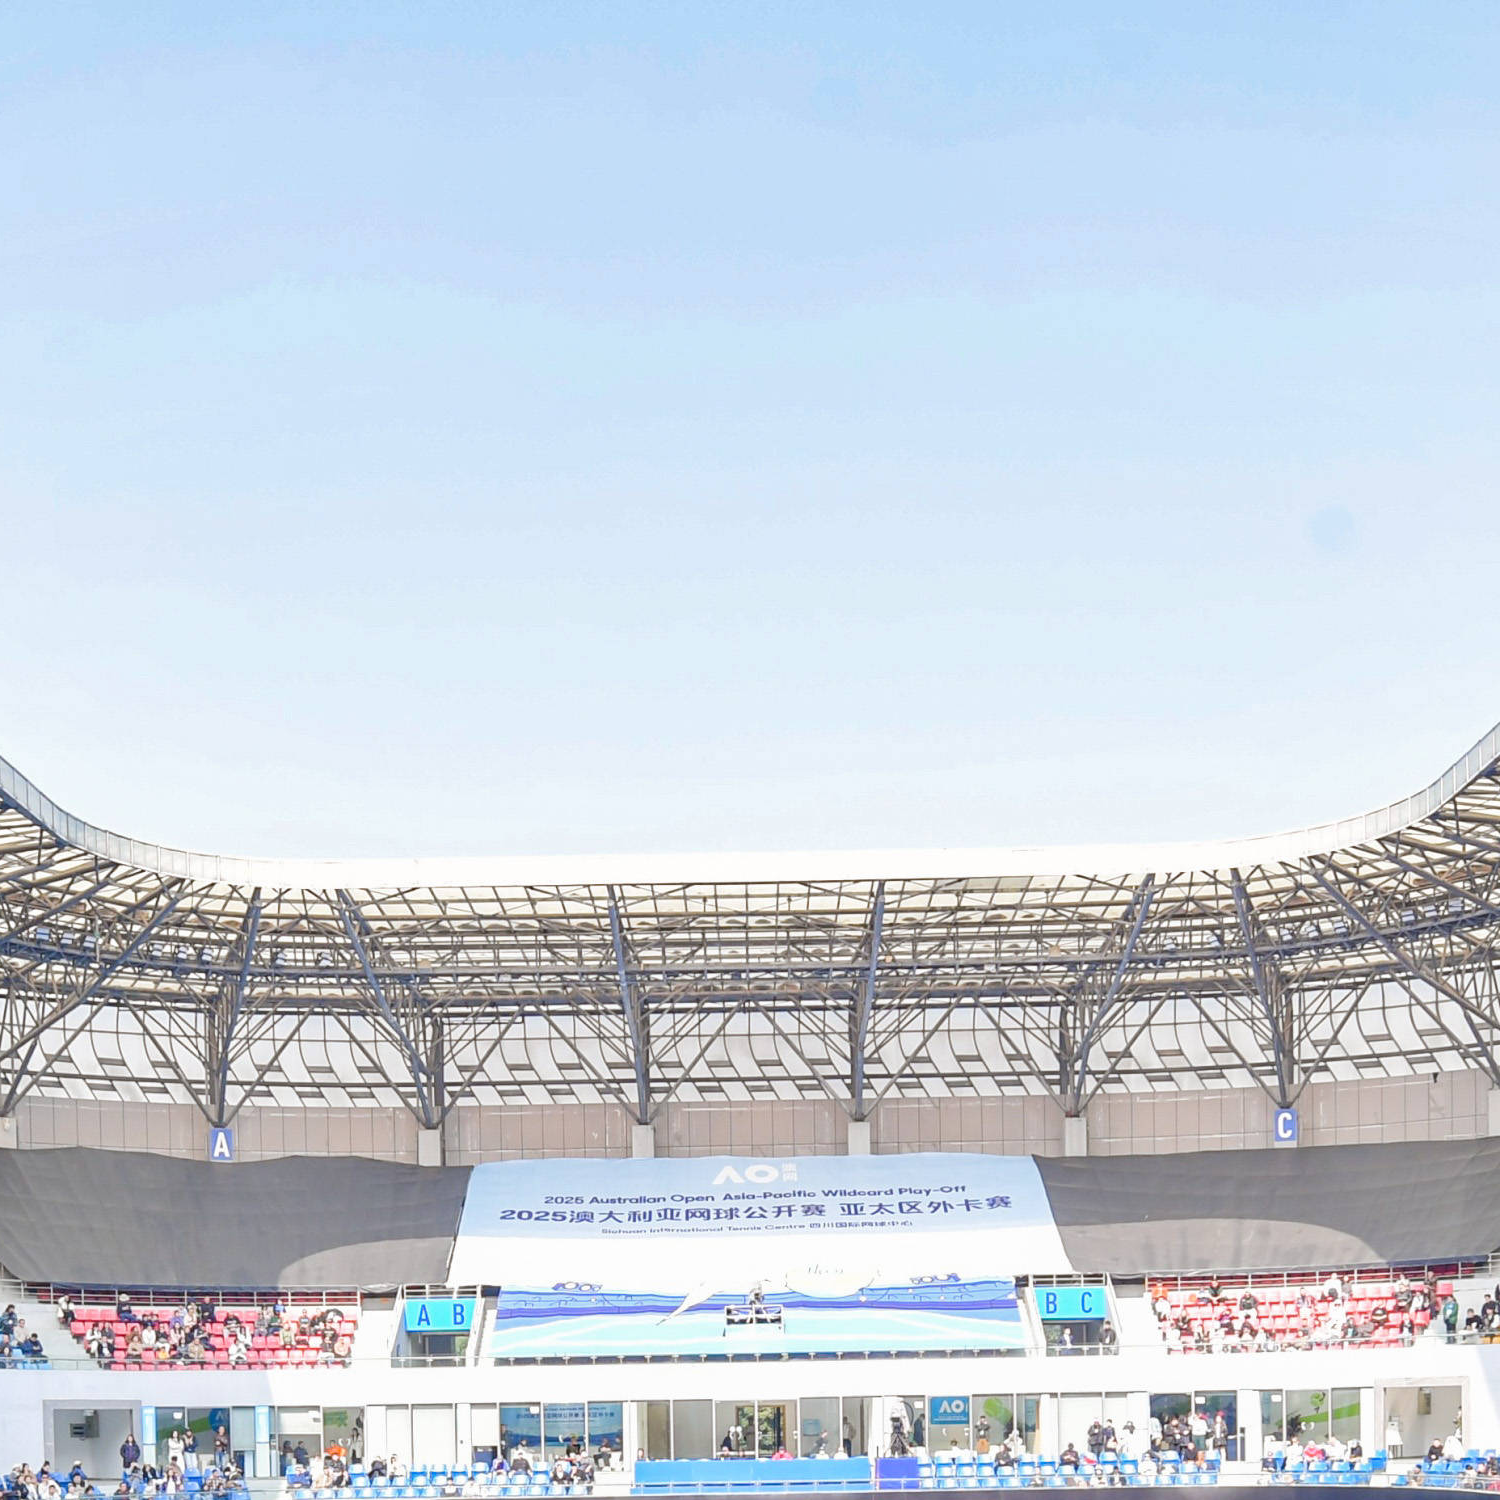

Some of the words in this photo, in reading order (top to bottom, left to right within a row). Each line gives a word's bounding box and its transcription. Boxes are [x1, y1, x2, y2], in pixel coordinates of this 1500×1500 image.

[1278, 1112, 1292, 1138] C
[213, 1132, 230, 1158] A
[712, 1164, 779, 1185] AO
[544, 1196, 584, 1204] 2025
[589, 1195, 667, 1204] Australian
[670, 1194, 715, 1204] Open
[723, 1189, 816, 1201] Asia-Pacific
[821, 1188, 894, 1198] Wildcard
[898, 1185, 967, 1197] Play-Off
[500, 1203, 826, 1223] 2025澳大利亚网球公开赛
[840, 1195, 1013, 1216] 亚太区外卡赛
[1046, 1292, 1057, 1314] B
[1081, 1292, 1093, 1313] C
[417, 1304, 431, 1326] A
[453, 1303, 465, 1325] B
[939, 1400, 964, 1413] AO
